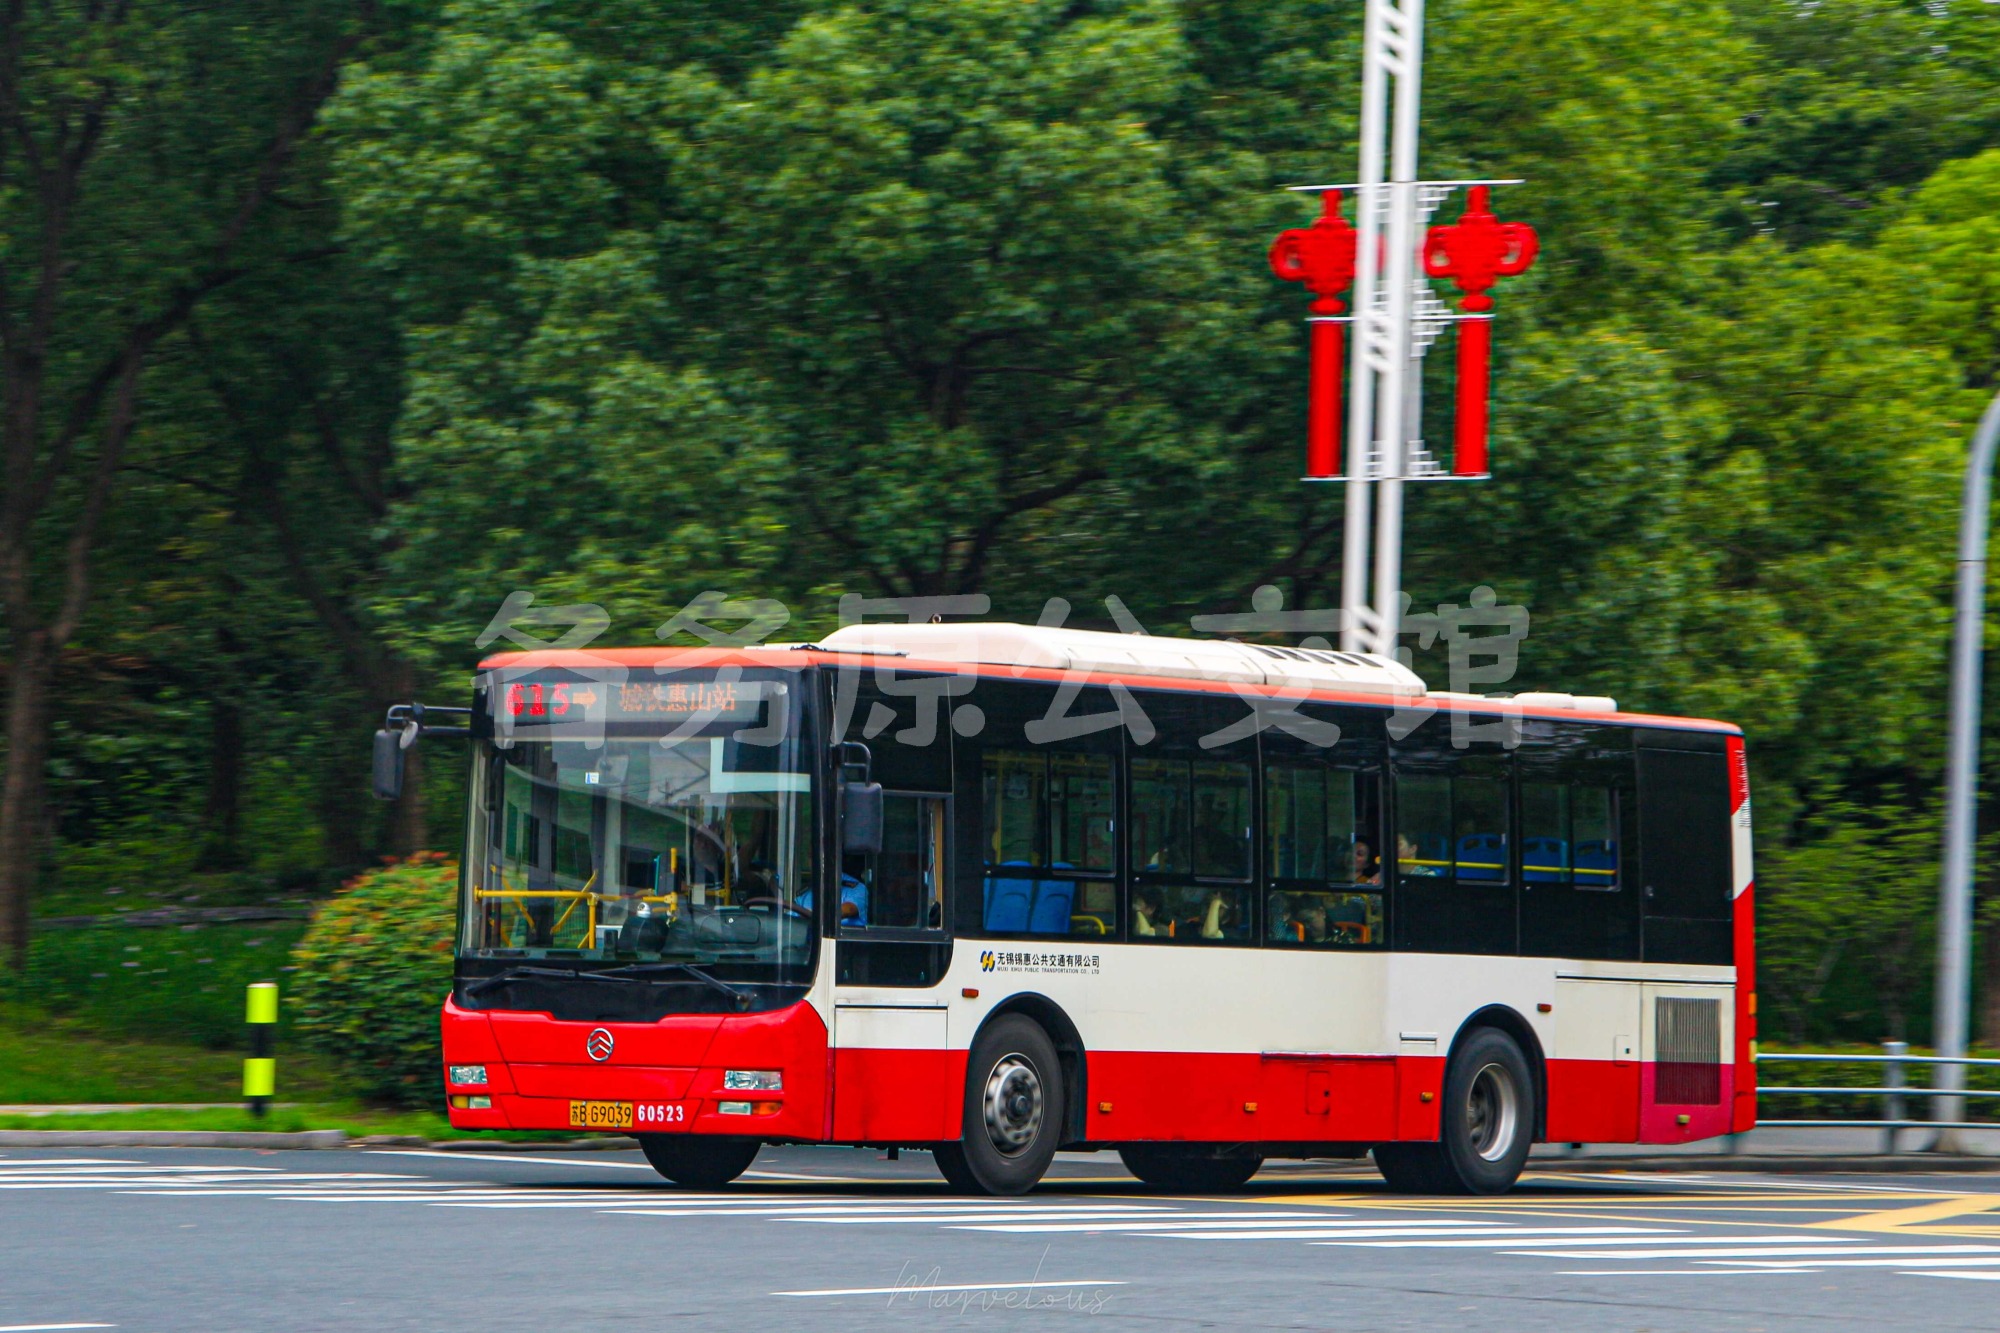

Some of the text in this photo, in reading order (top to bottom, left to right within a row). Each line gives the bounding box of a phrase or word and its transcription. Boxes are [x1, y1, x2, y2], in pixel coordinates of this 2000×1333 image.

[506, 683, 570, 715] 615
[997, 952, 1100, 968] 无锡锡惠公共交通有限公司
[638, 1105, 684, 1122] 60523
